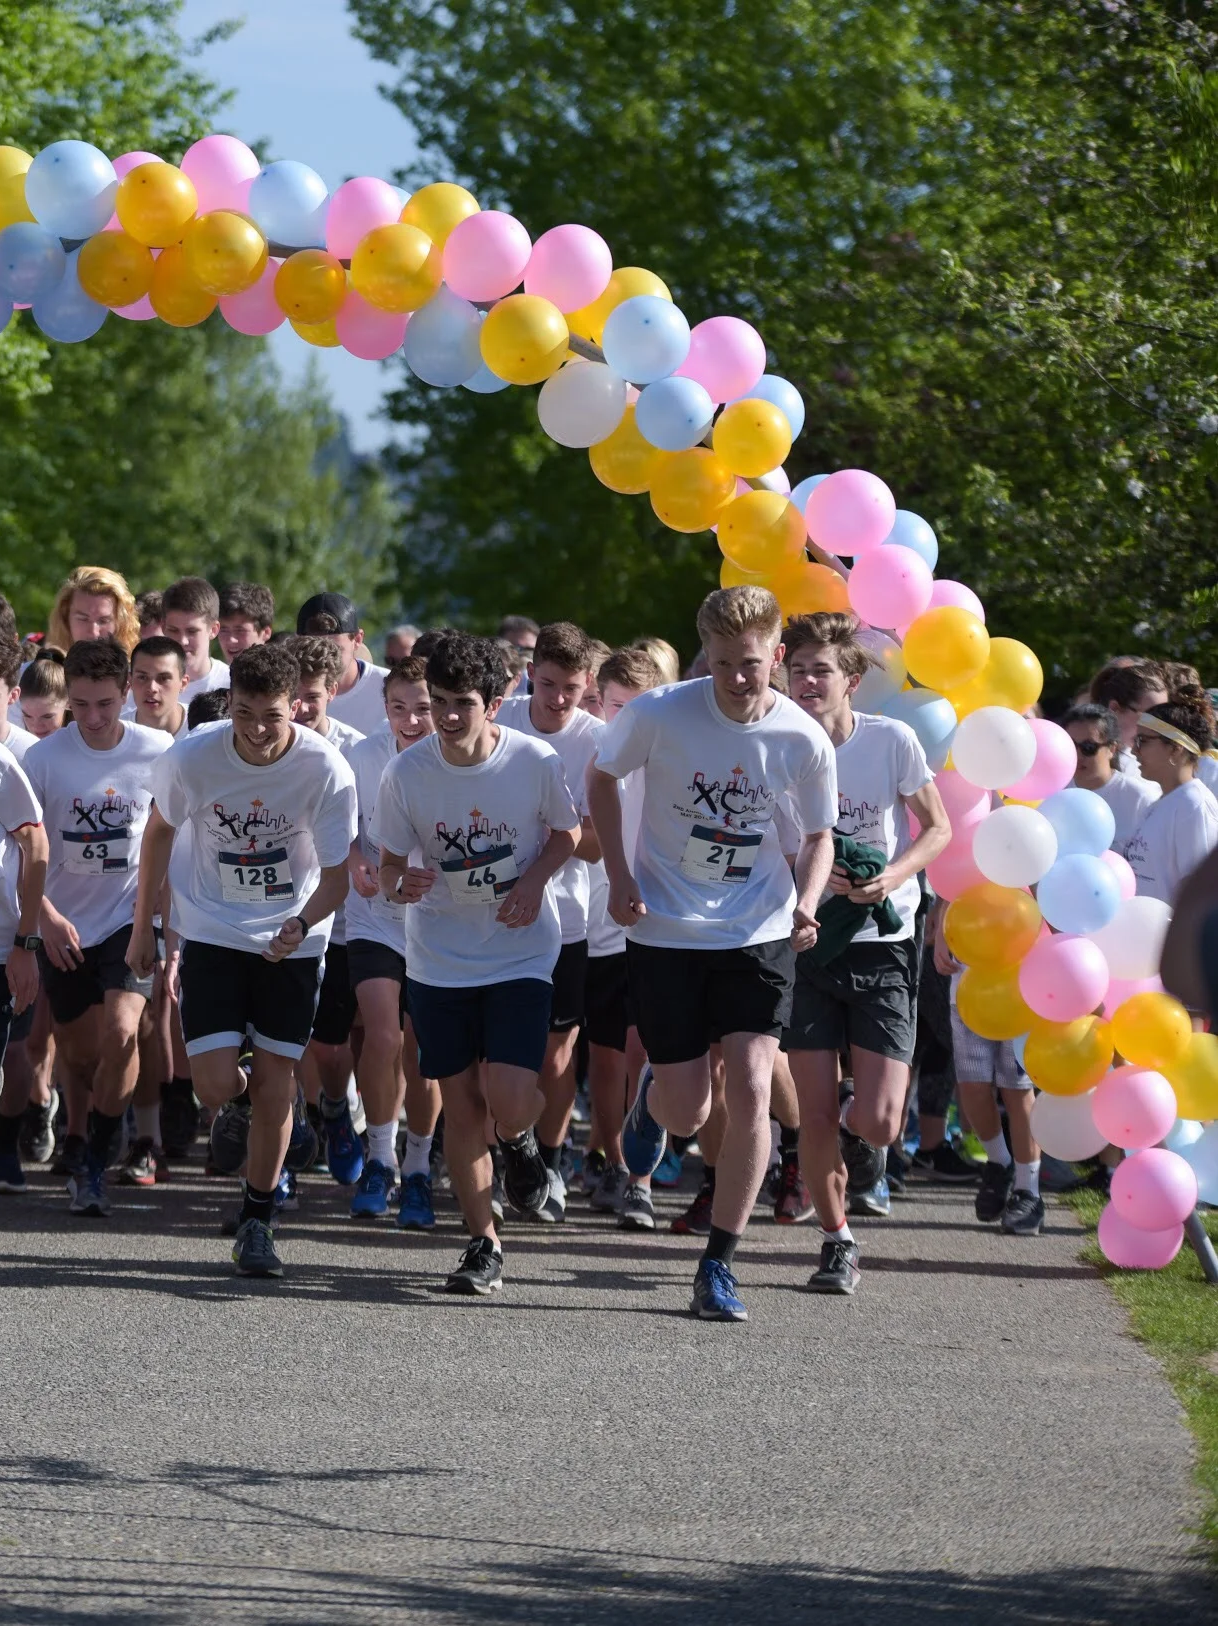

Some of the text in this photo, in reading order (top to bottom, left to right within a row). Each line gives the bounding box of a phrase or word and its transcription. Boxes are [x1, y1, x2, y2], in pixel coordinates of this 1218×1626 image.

[82, 843, 109, 859] 63
[706, 845, 737, 866] 21
[233, 866, 278, 886] 128
[467, 866, 497, 888] 46
